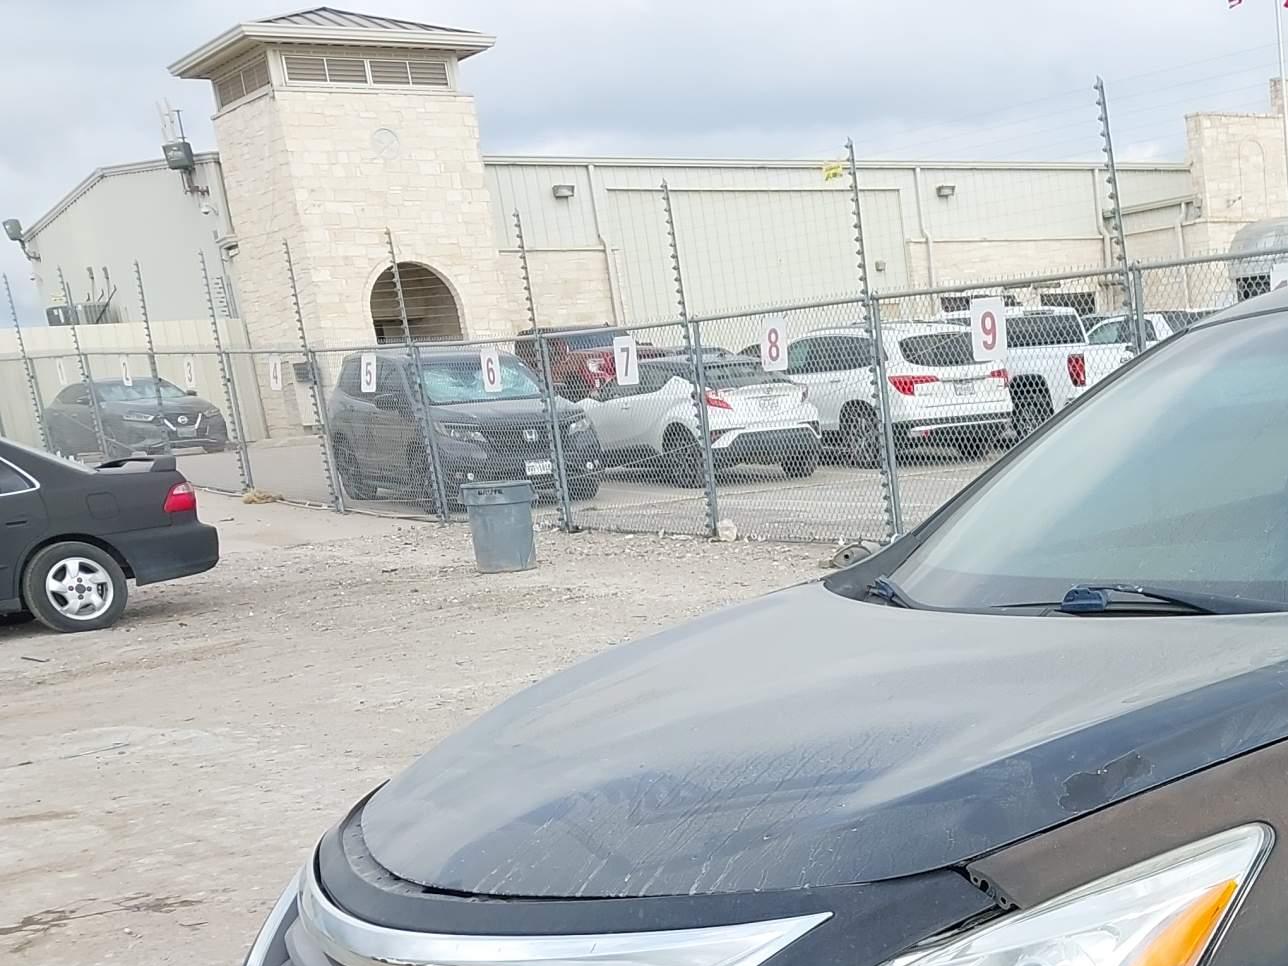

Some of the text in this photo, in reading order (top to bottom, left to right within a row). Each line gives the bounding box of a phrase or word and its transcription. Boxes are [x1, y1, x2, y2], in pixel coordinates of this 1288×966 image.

[766, 328, 780, 362] 8
[981, 311, 998, 351] 9
[186, 361, 193, 382] 3
[272, 362, 279, 385] 4
[365, 362, 373, 386] 5
[486, 357, 496, 385] 6
[620, 347, 630, 377] 7
